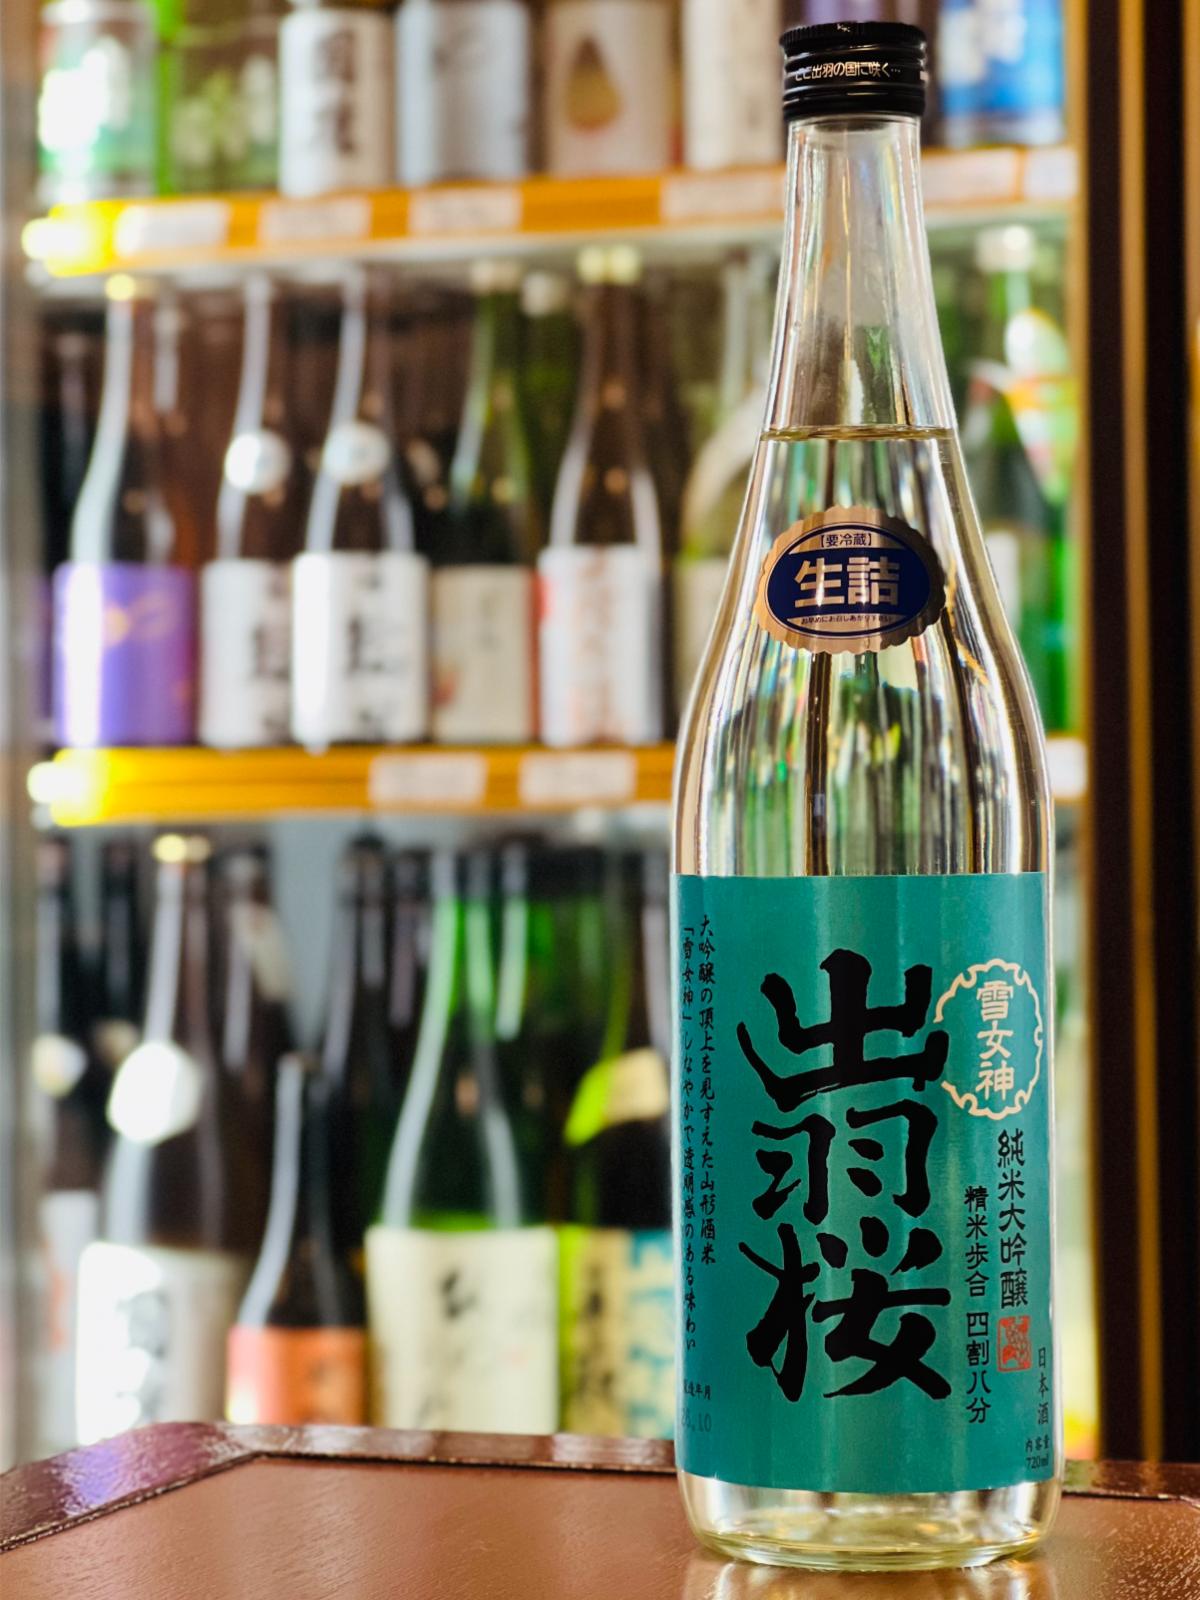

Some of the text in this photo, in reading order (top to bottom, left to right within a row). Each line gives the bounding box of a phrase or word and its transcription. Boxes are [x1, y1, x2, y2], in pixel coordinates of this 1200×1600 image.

[794, 556, 900, 609] 生詰
[975, 980, 1015, 1101] 雪女神
[736, 948, 952, 1402] 出羽桜
[997, 1128, 1029, 1309] 純米大吟醸
[1037, 1346, 1049, 1425] 日本酒
